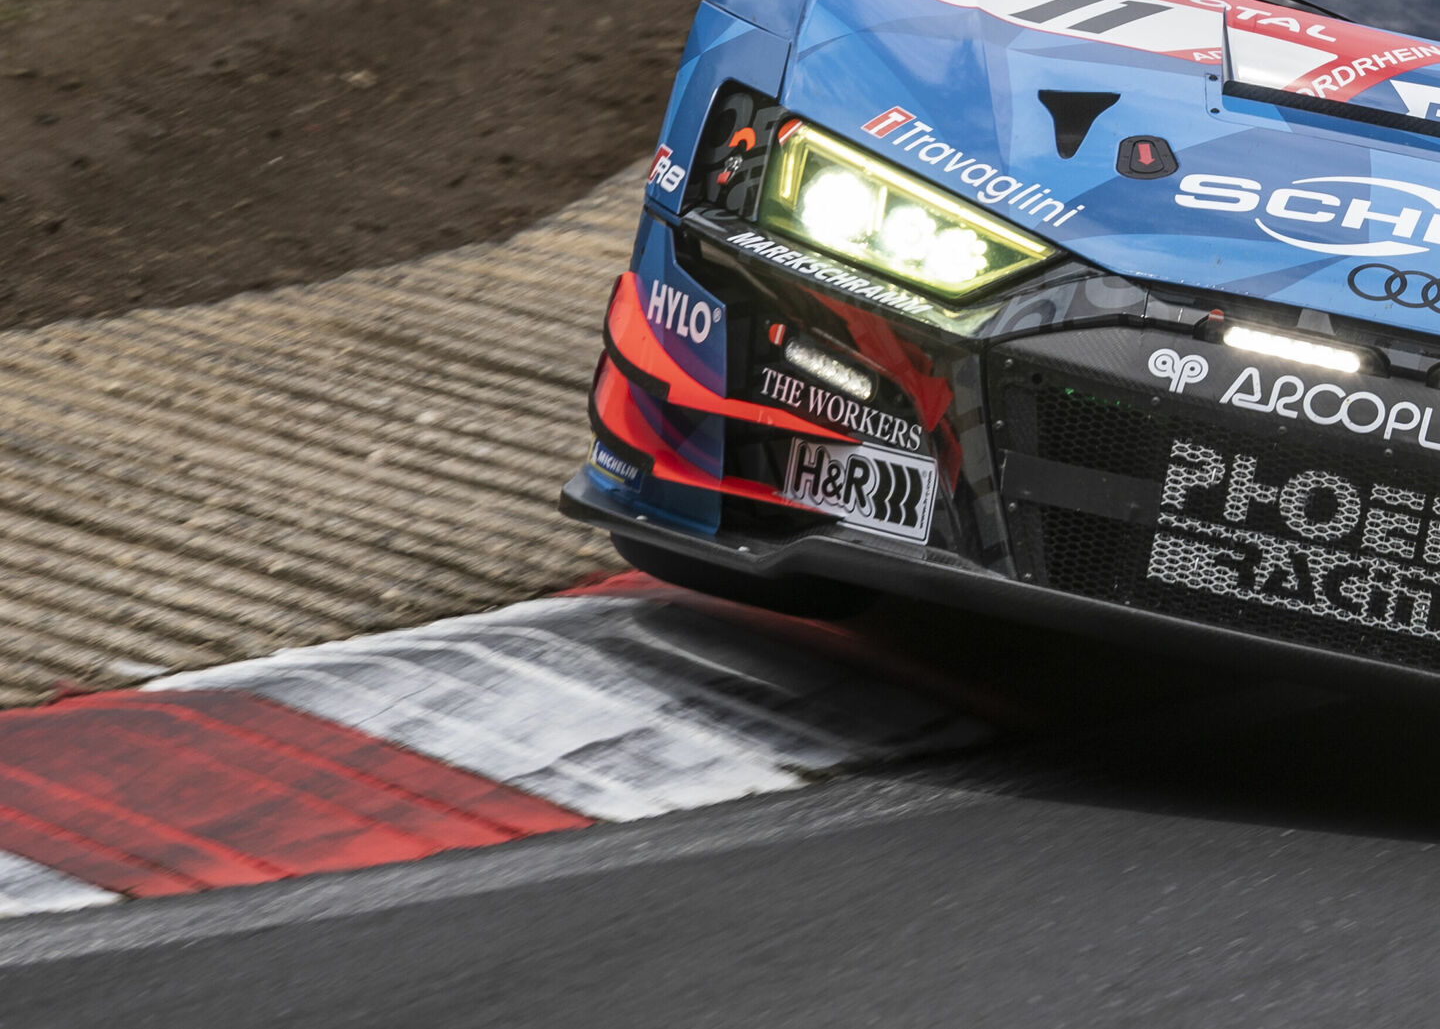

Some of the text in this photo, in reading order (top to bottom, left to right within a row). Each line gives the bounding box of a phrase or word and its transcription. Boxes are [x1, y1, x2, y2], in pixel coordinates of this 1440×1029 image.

[893, 121, 1085, 228] Travaglini
[761, 366, 923, 452] THE WORKERS
[597, 450, 639, 480] MICHELIN
[792, 442, 873, 518] H&R
